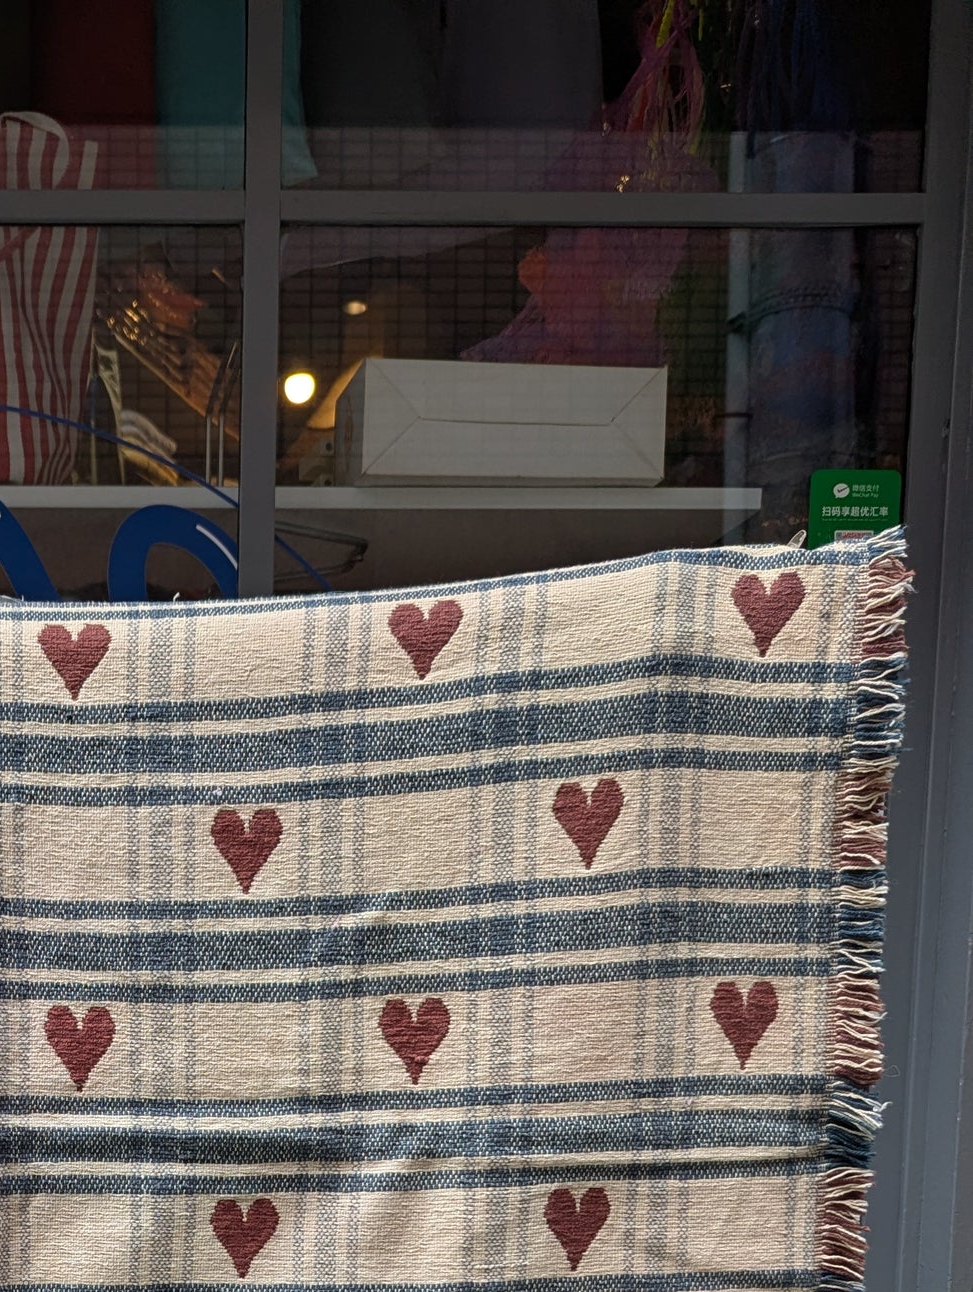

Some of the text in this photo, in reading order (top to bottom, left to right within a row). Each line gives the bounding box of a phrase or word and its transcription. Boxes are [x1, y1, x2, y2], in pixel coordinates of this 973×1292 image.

[822, 506, 888, 517] 扫码享超优汇率
